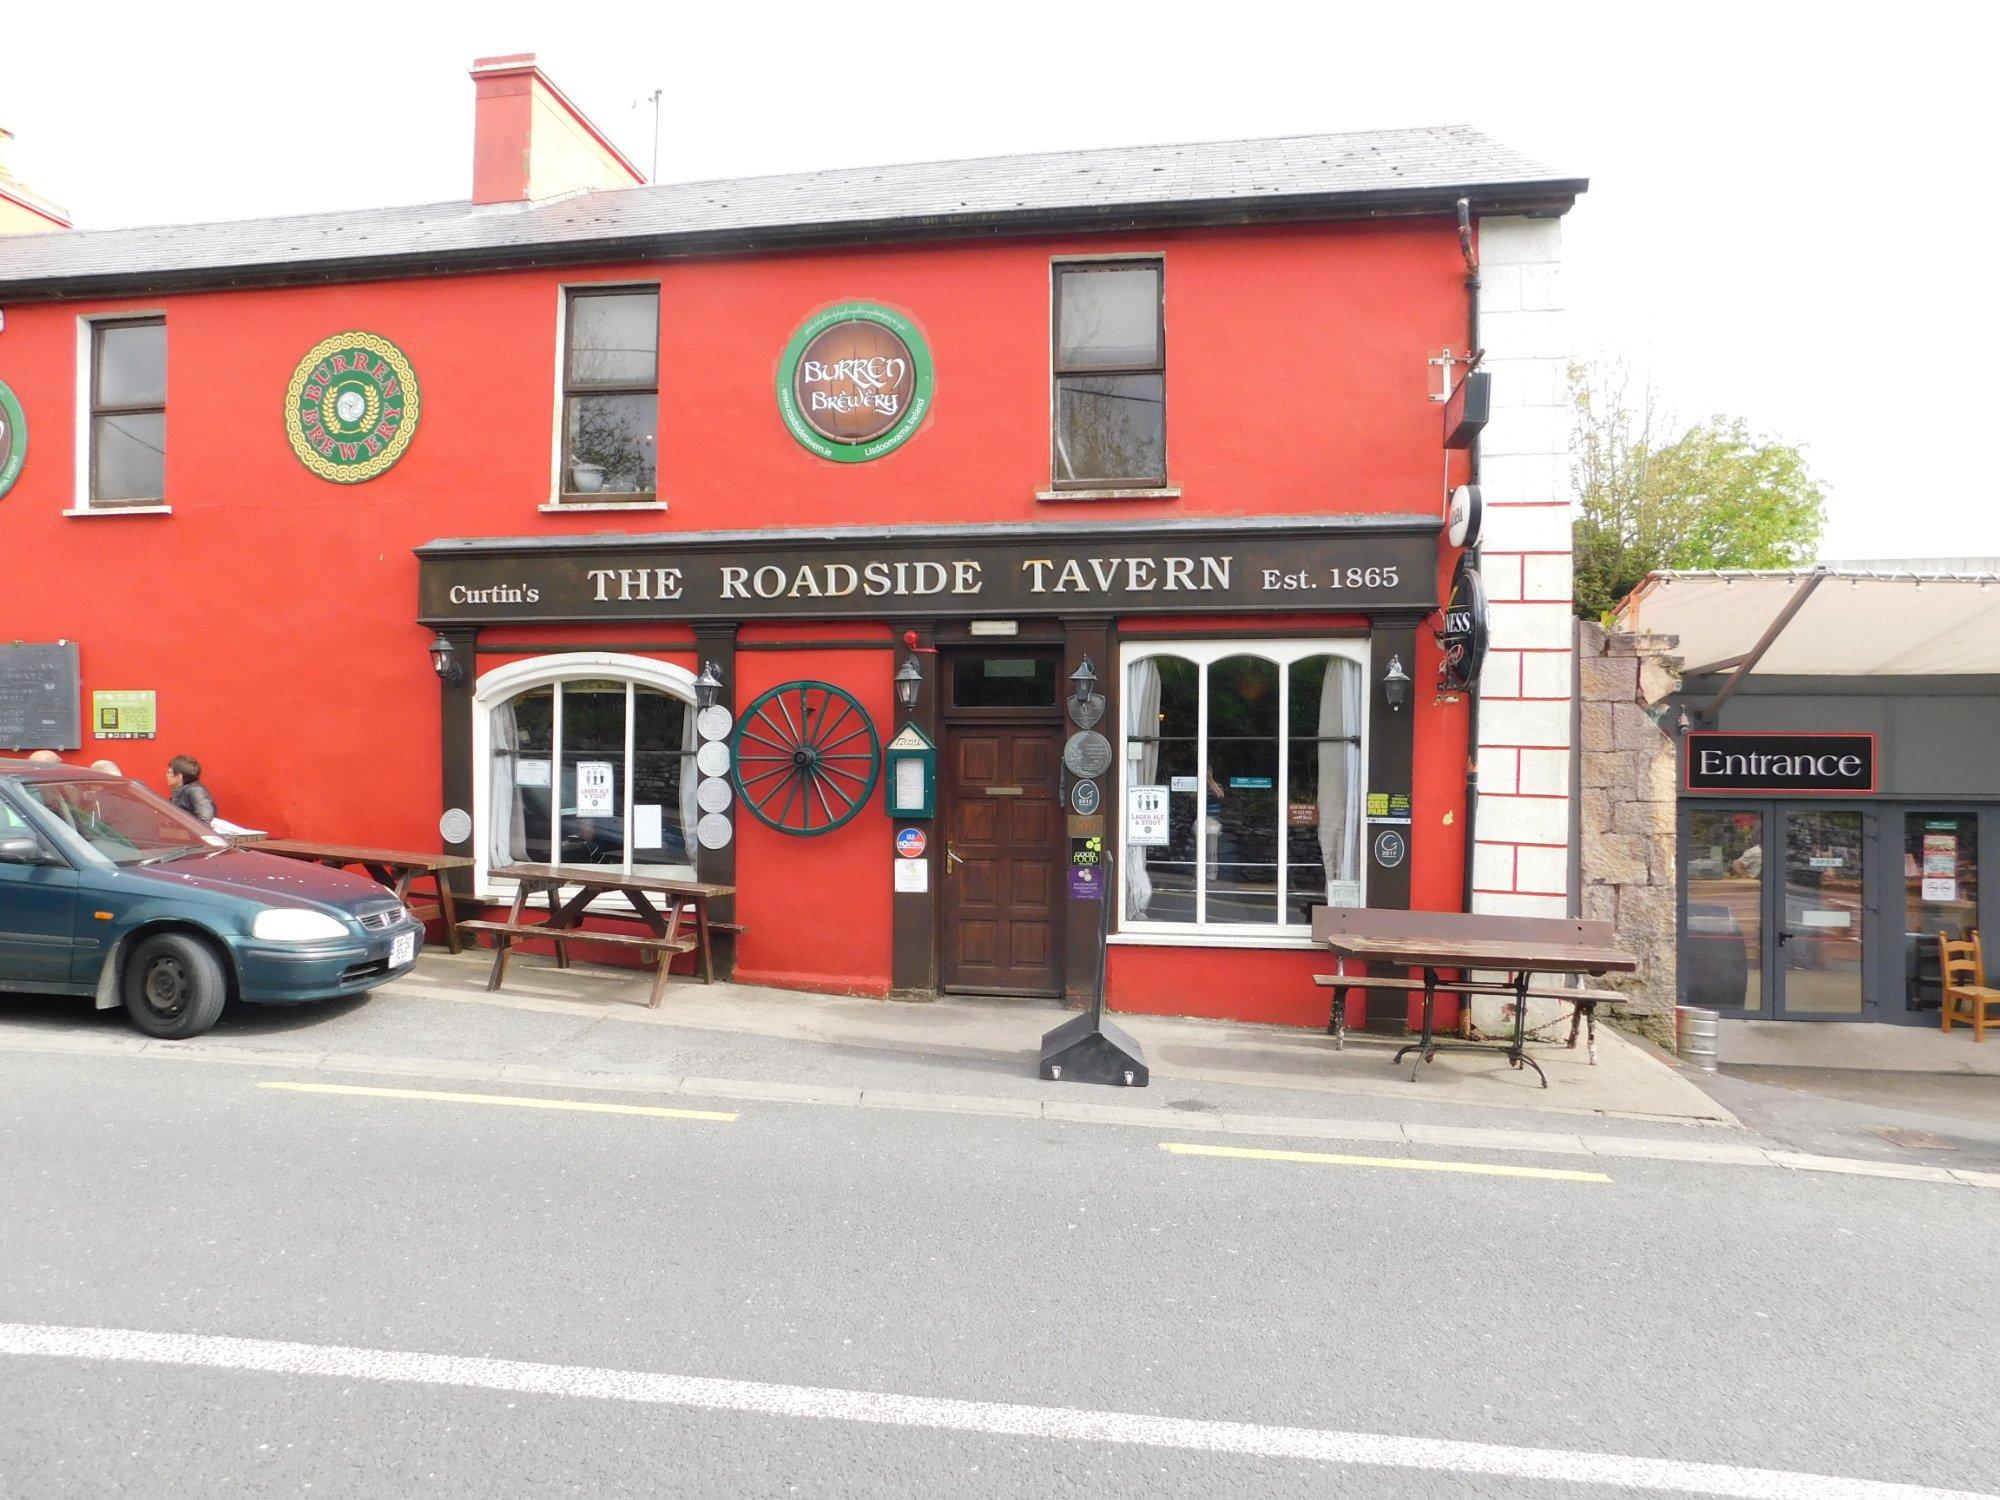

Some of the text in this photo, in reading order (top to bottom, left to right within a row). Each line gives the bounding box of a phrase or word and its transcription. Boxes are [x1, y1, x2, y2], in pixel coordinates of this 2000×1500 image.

[304, 353, 401, 404] BURREN
[302, 403, 401, 460] BREWERY
[908, 398, 926, 428] Ireland
[449, 556, 1400, 604] Curtin's THE ROADSIDE TAVERN Est. 1865
[1699, 750, 1862, 777] Entrance
[1073, 855, 1099, 863] FOOD
